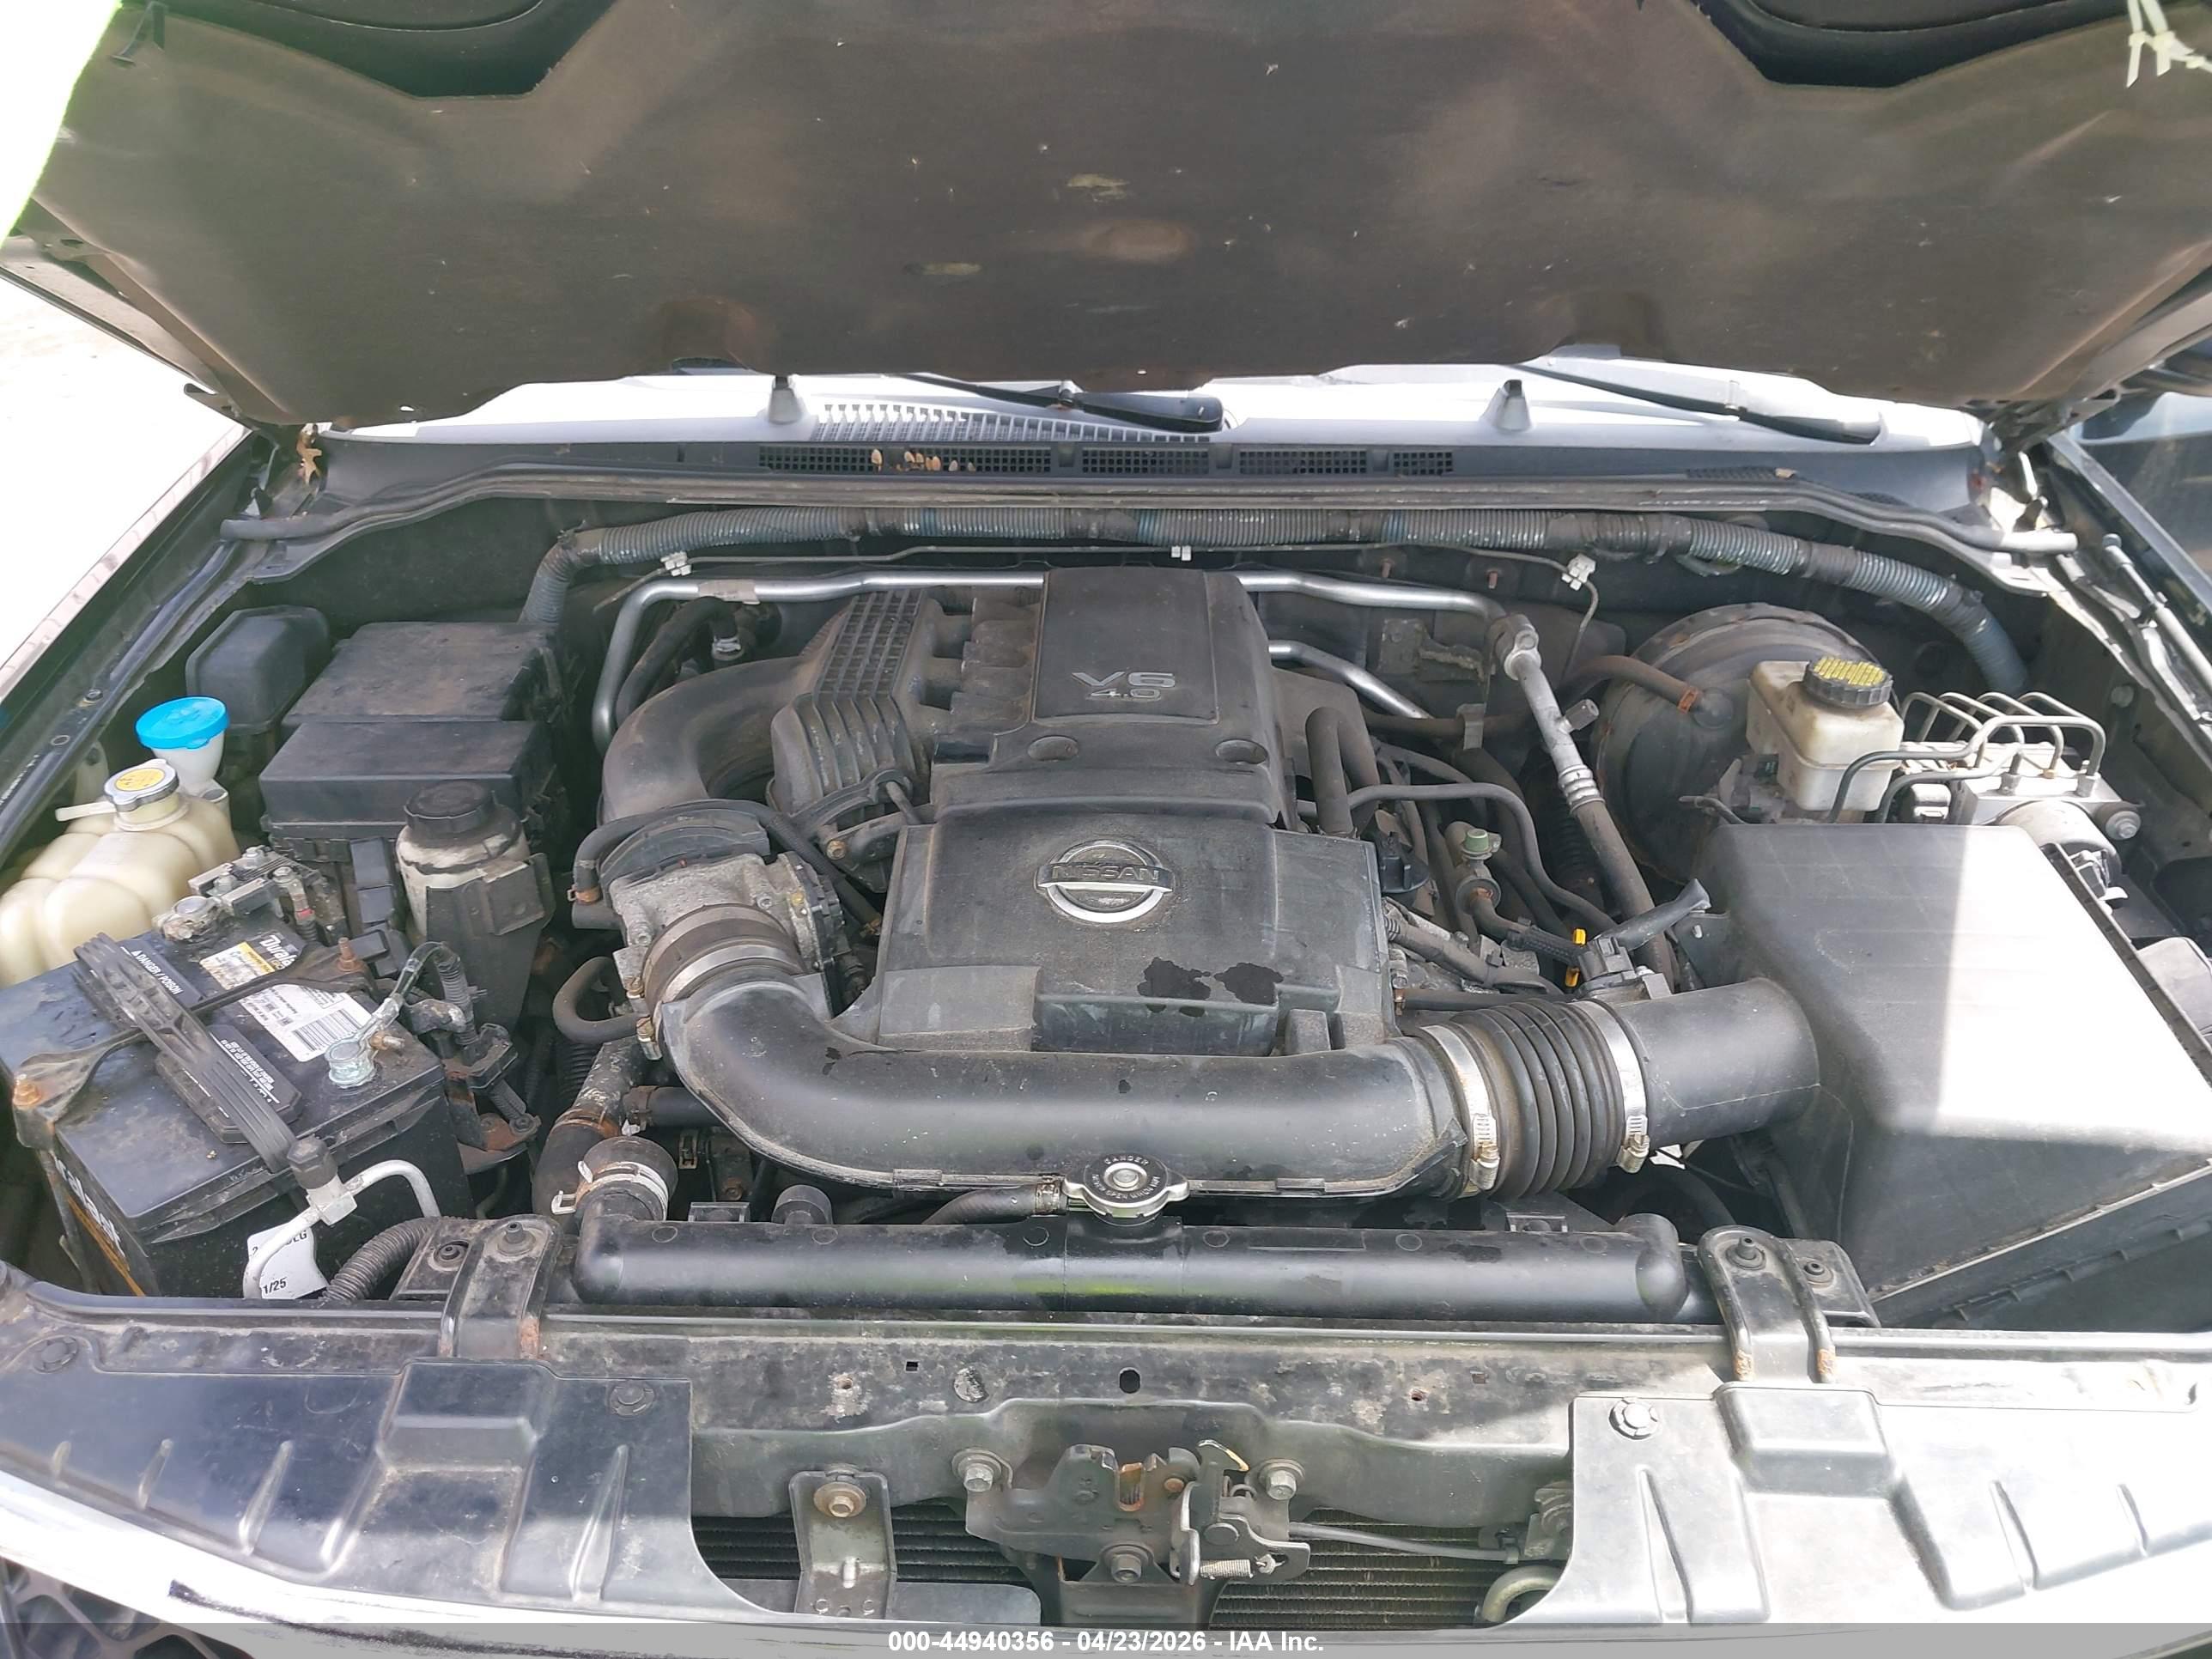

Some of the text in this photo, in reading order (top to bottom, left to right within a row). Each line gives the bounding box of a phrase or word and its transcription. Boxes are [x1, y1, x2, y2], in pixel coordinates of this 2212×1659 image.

[1072, 672, 1175, 688] V6
[1087, 687, 1161, 701] 4.0
[1050, 864, 1159, 882] NISSAN
[135, 953, 161, 978] DANGER
[158, 973, 184, 996] POISON
